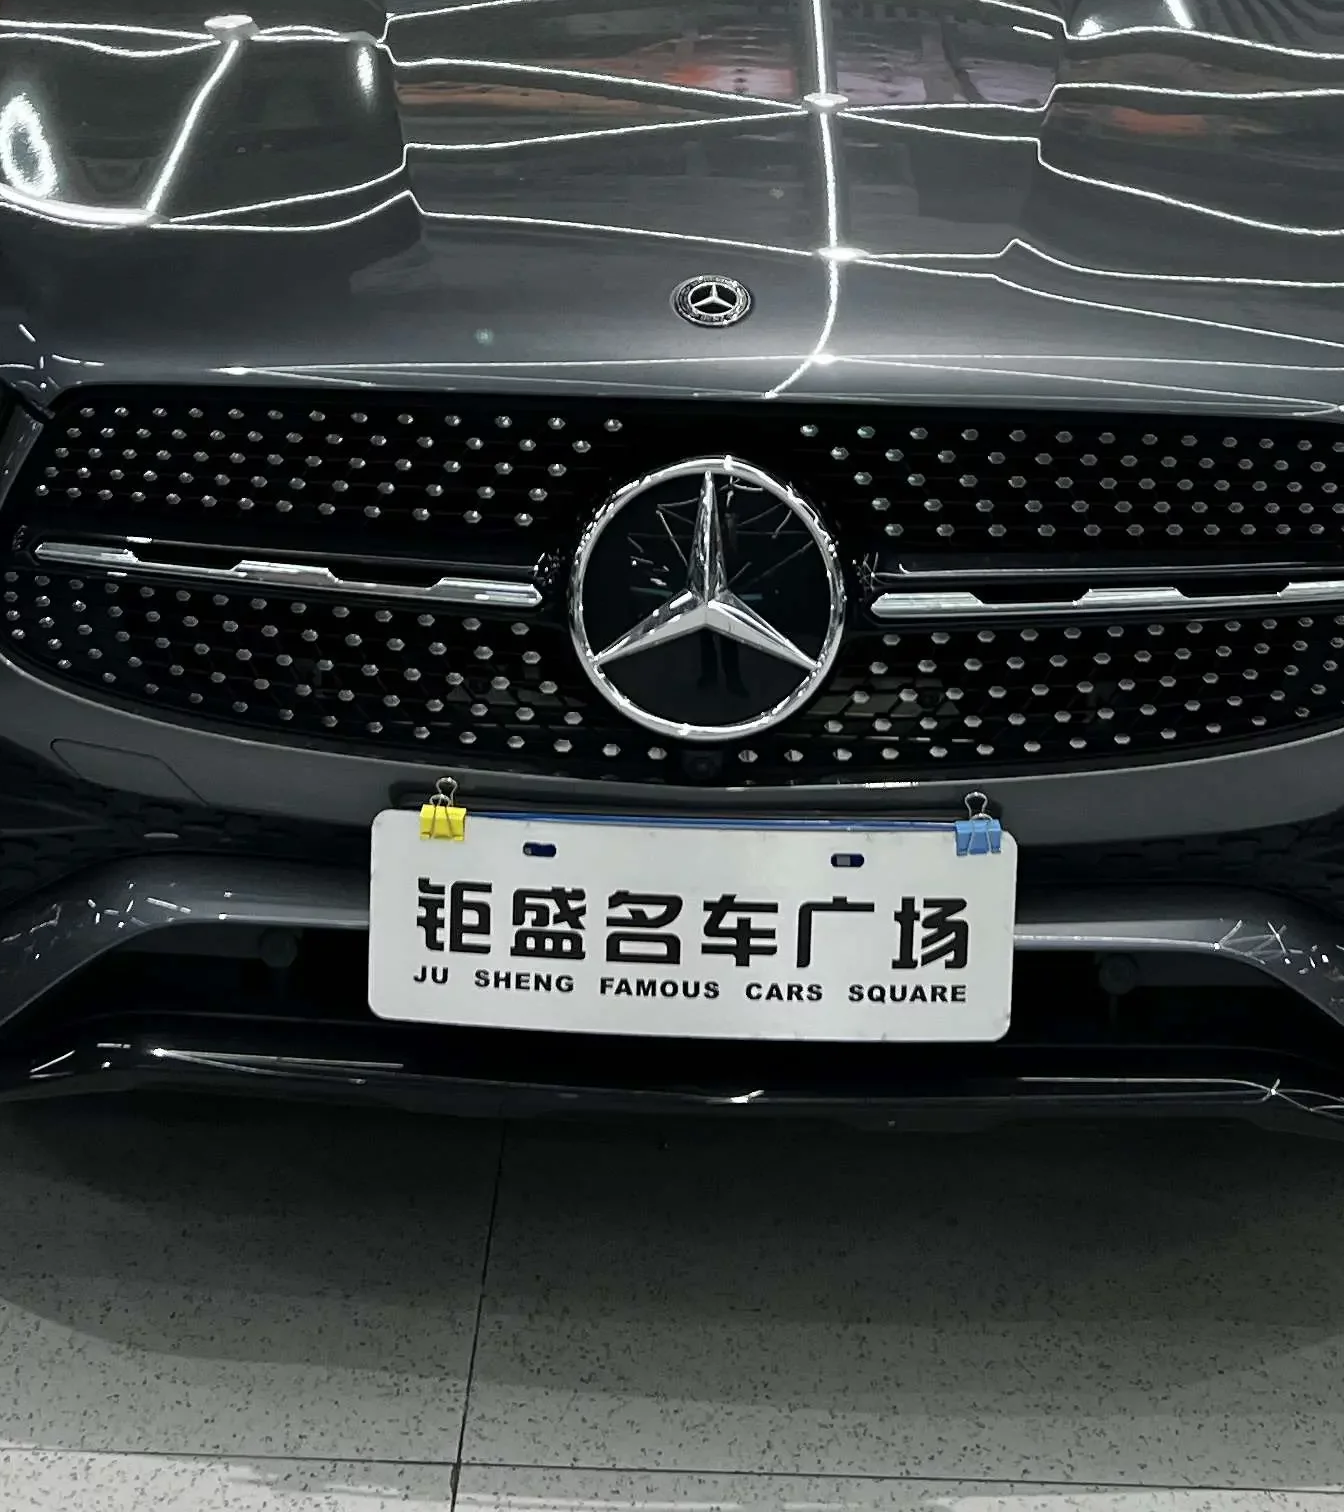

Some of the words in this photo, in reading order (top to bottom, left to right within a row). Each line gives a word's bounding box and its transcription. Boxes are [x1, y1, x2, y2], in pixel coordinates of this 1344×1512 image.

[416, 876, 969, 971] 钜盛名车广场
[413, 965, 449, 985] JU
[474, 968, 575, 993] SHENG
[599, 976, 720, 1000] FAMOUS
[745, 981, 824, 1002] CARS
[847, 983, 967, 1005] SQUARE
